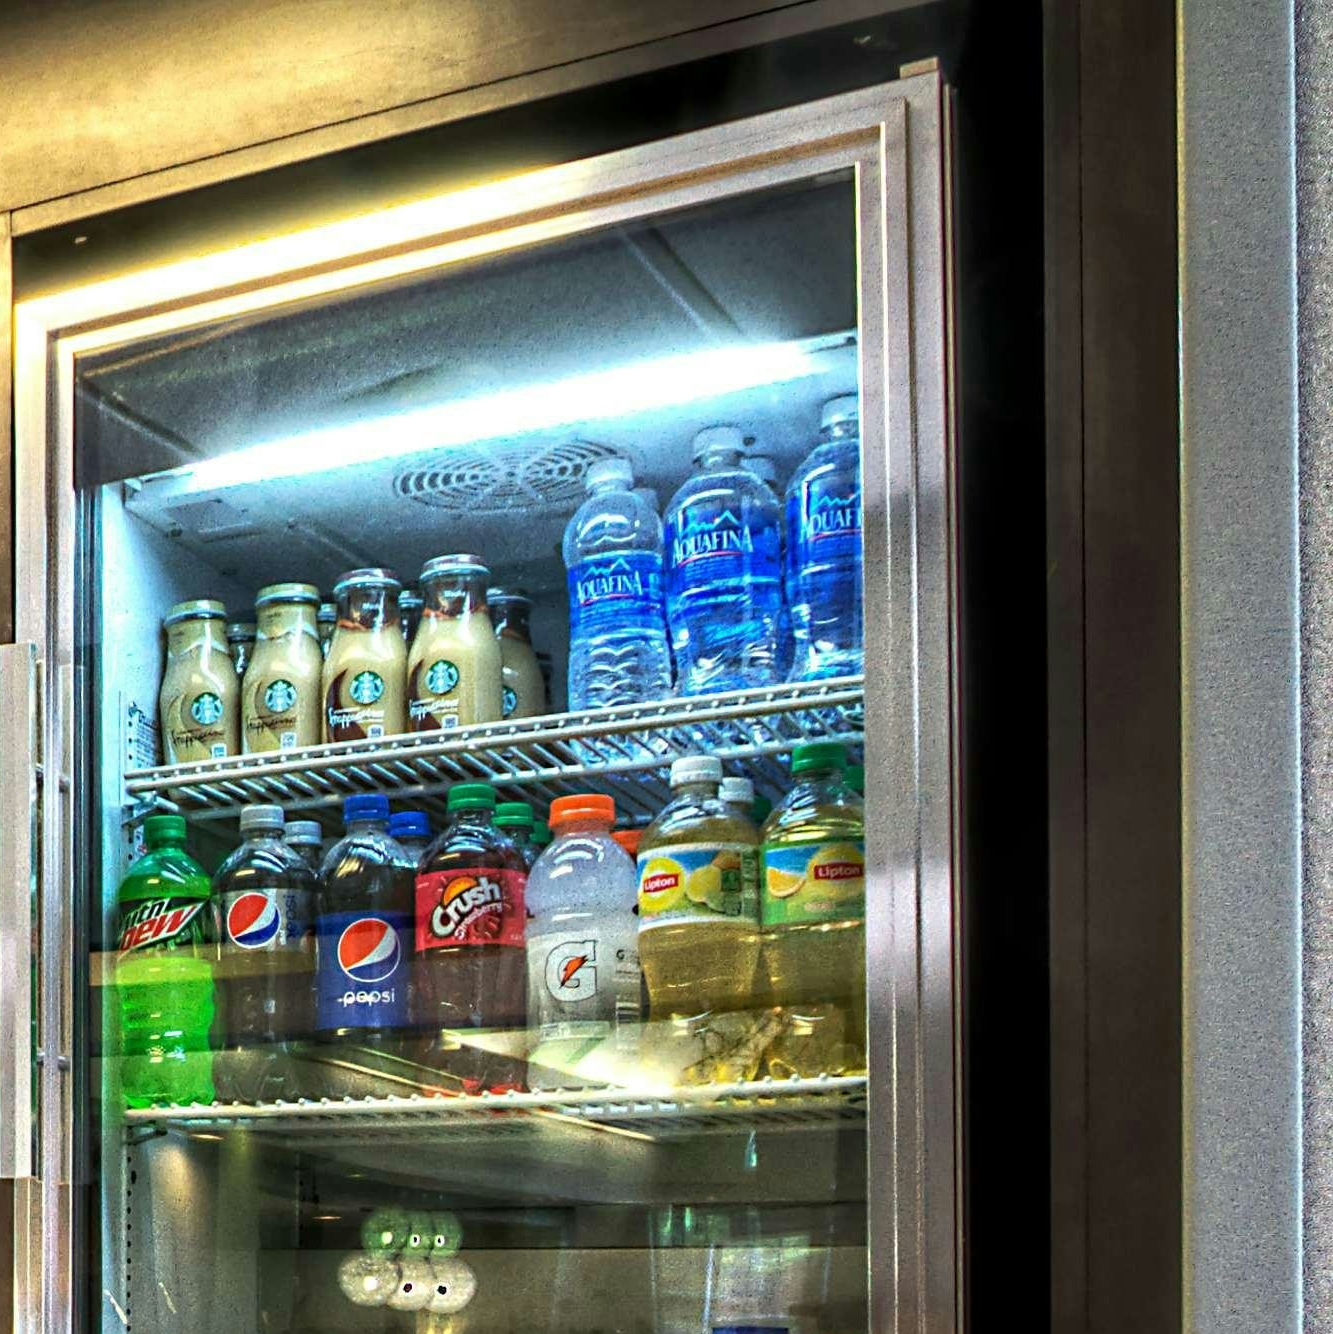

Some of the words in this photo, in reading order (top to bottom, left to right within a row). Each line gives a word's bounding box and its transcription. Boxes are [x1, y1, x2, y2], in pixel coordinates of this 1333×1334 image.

[672, 525, 753, 568] AQUAFINA
[576, 571, 642, 600] AQUAFINA
[817, 864, 861, 879] Lipton
[643, 876, 676, 892] Lipton
[431, 876, 502, 937] Crush
[341, 988, 395, 1007] pepsi
